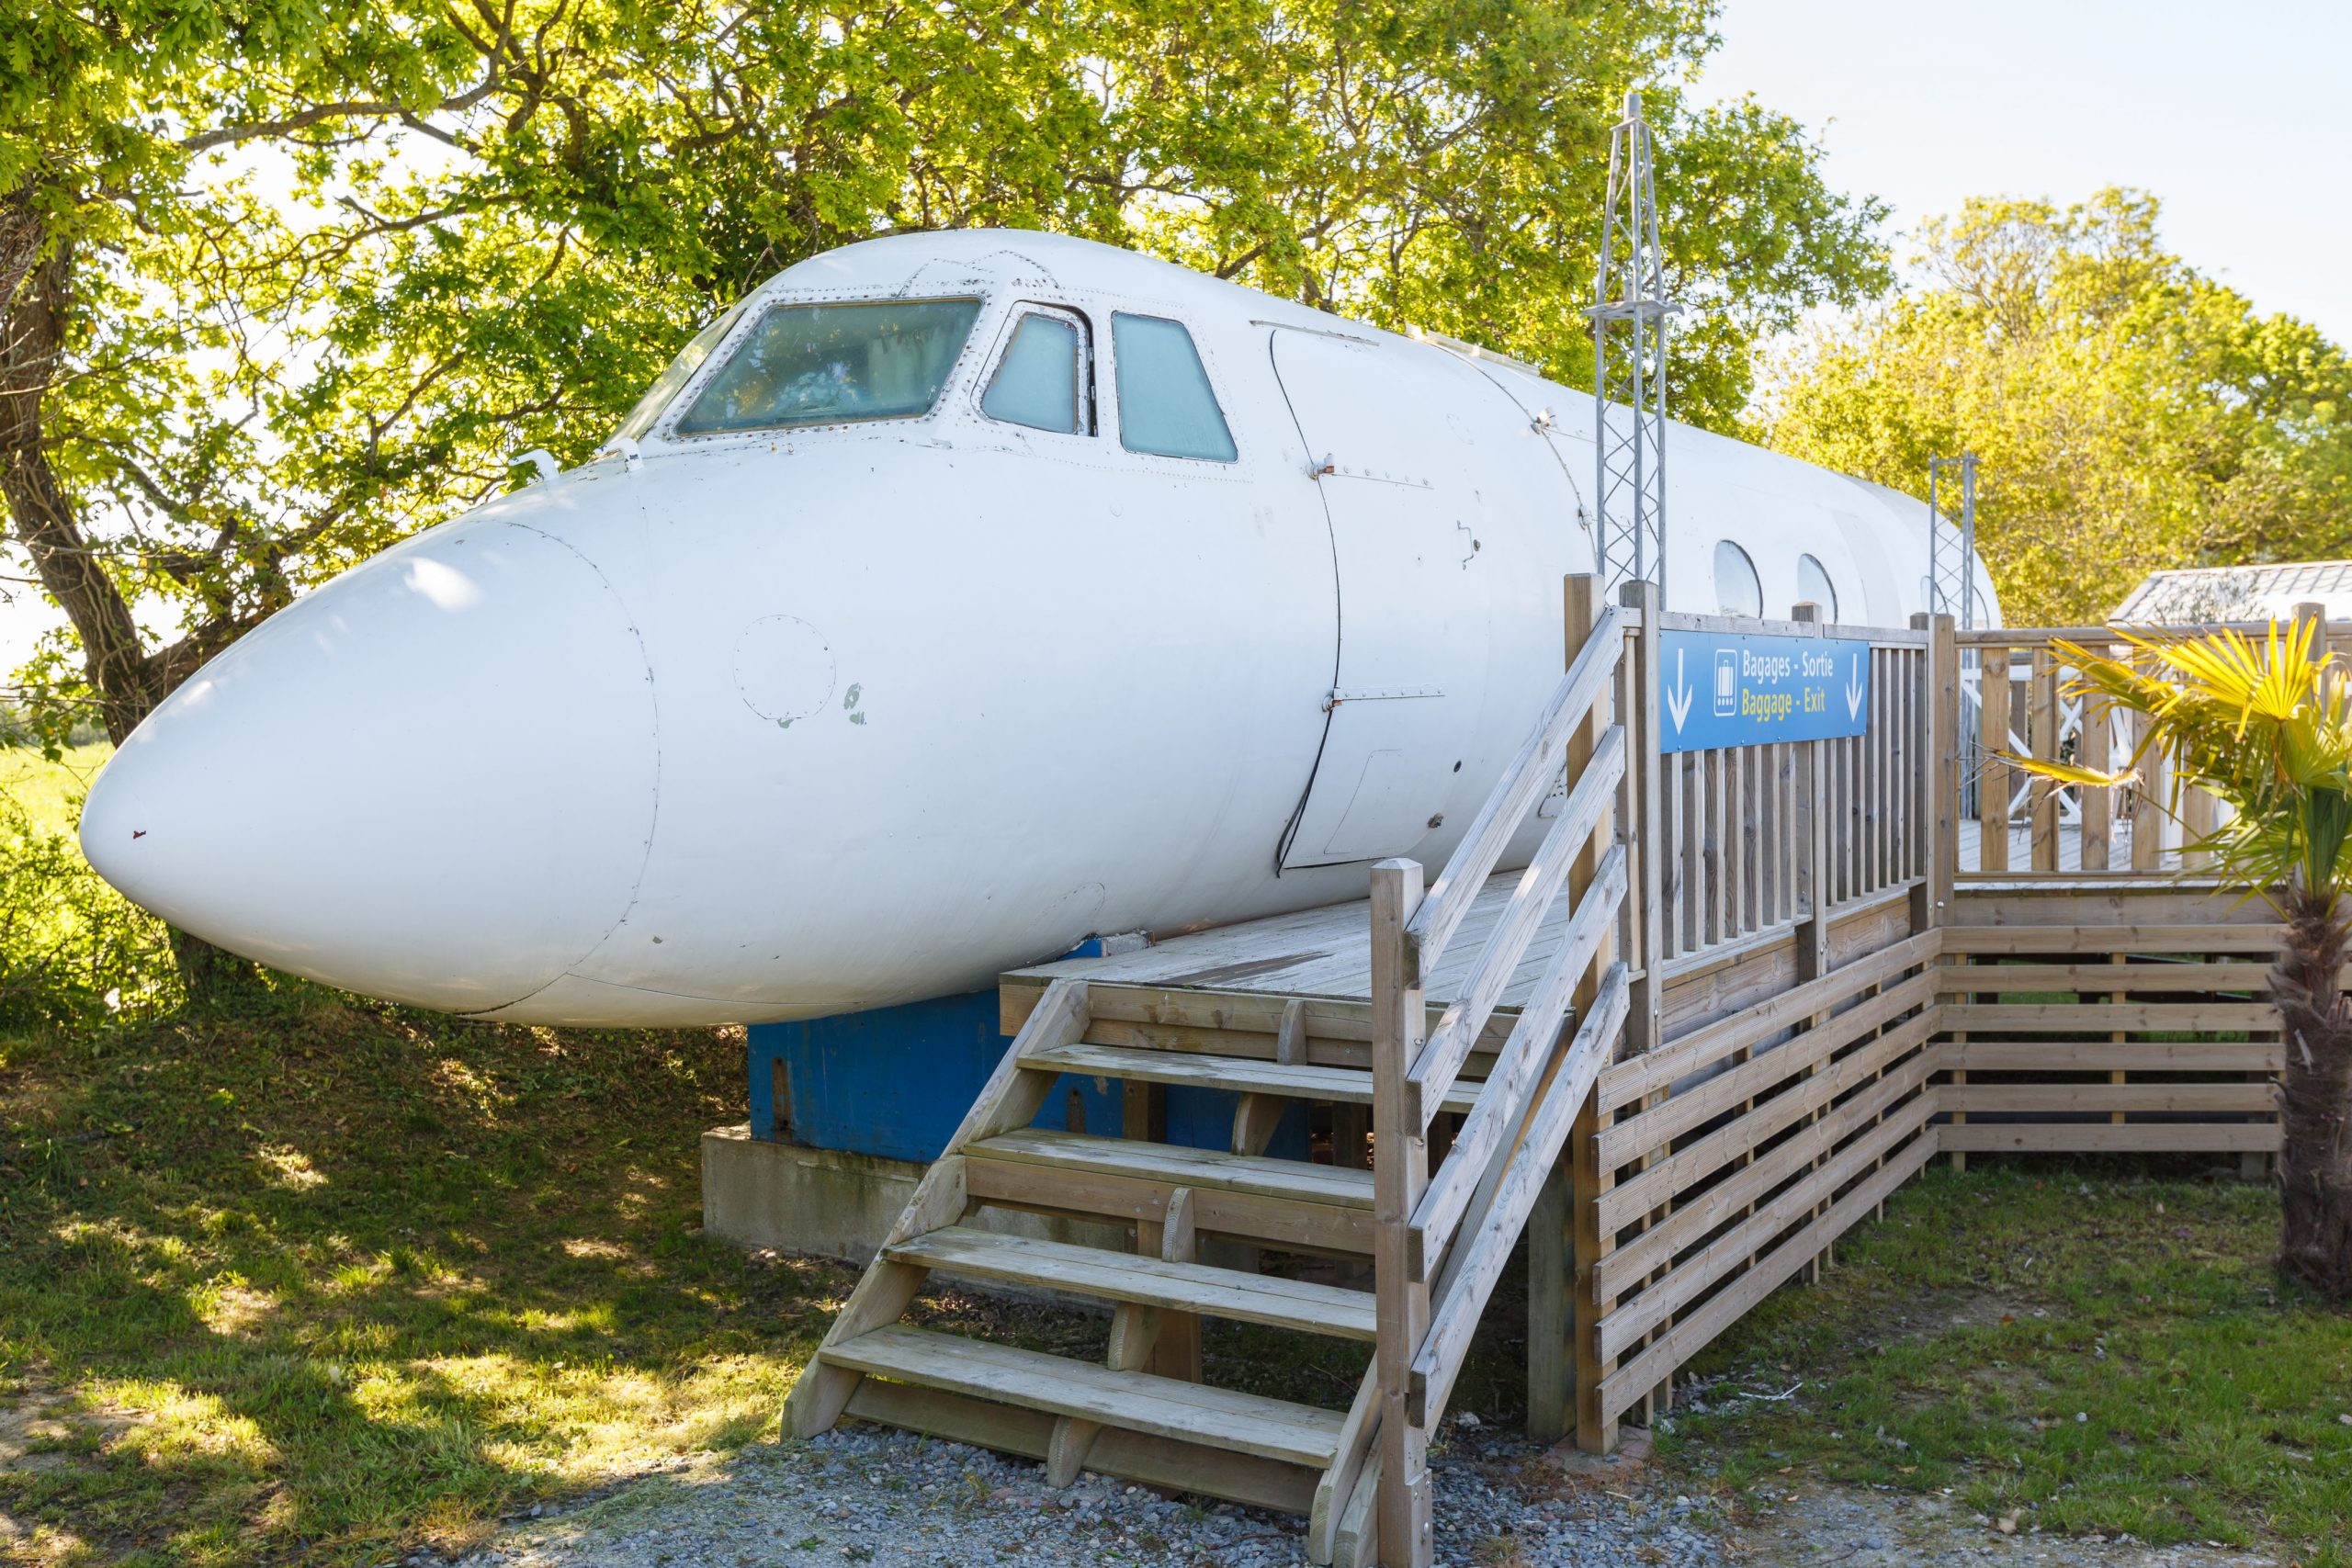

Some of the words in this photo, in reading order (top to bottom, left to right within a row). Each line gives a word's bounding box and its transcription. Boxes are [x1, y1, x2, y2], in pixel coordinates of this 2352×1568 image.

[1743, 649, 1790, 684] Bagages
[1803, 651, 1833, 677] Sortie
[1742, 688, 1792, 722] Baggage
[1804, 686, 1825, 712] Exit
